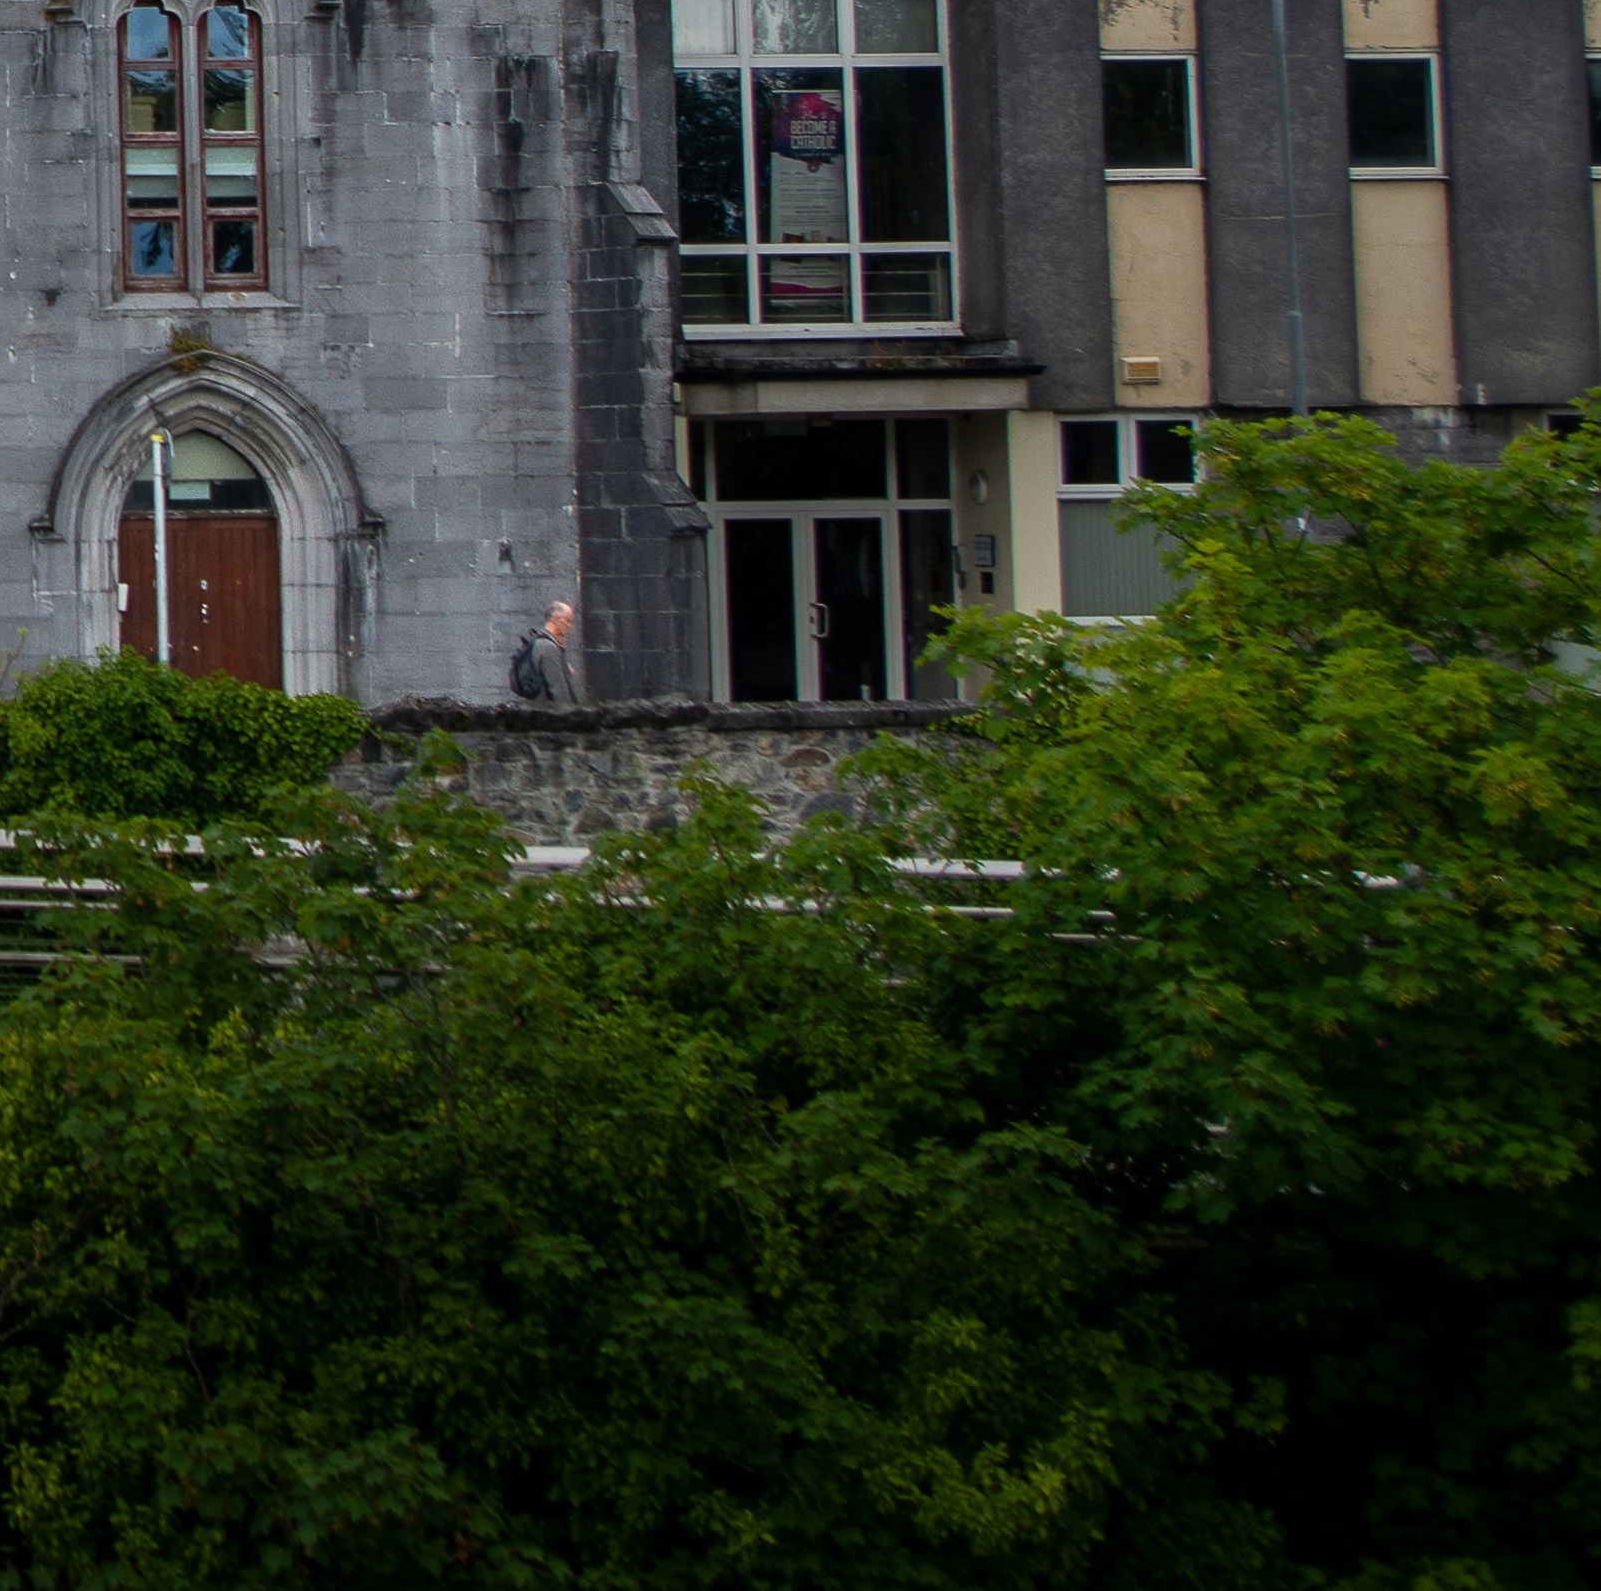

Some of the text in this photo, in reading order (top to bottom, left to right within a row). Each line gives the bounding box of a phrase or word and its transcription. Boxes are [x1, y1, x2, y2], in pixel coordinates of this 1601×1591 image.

[791, 120, 836, 134] BECOME A
[791, 135, 836, 149] CATHOLIC
